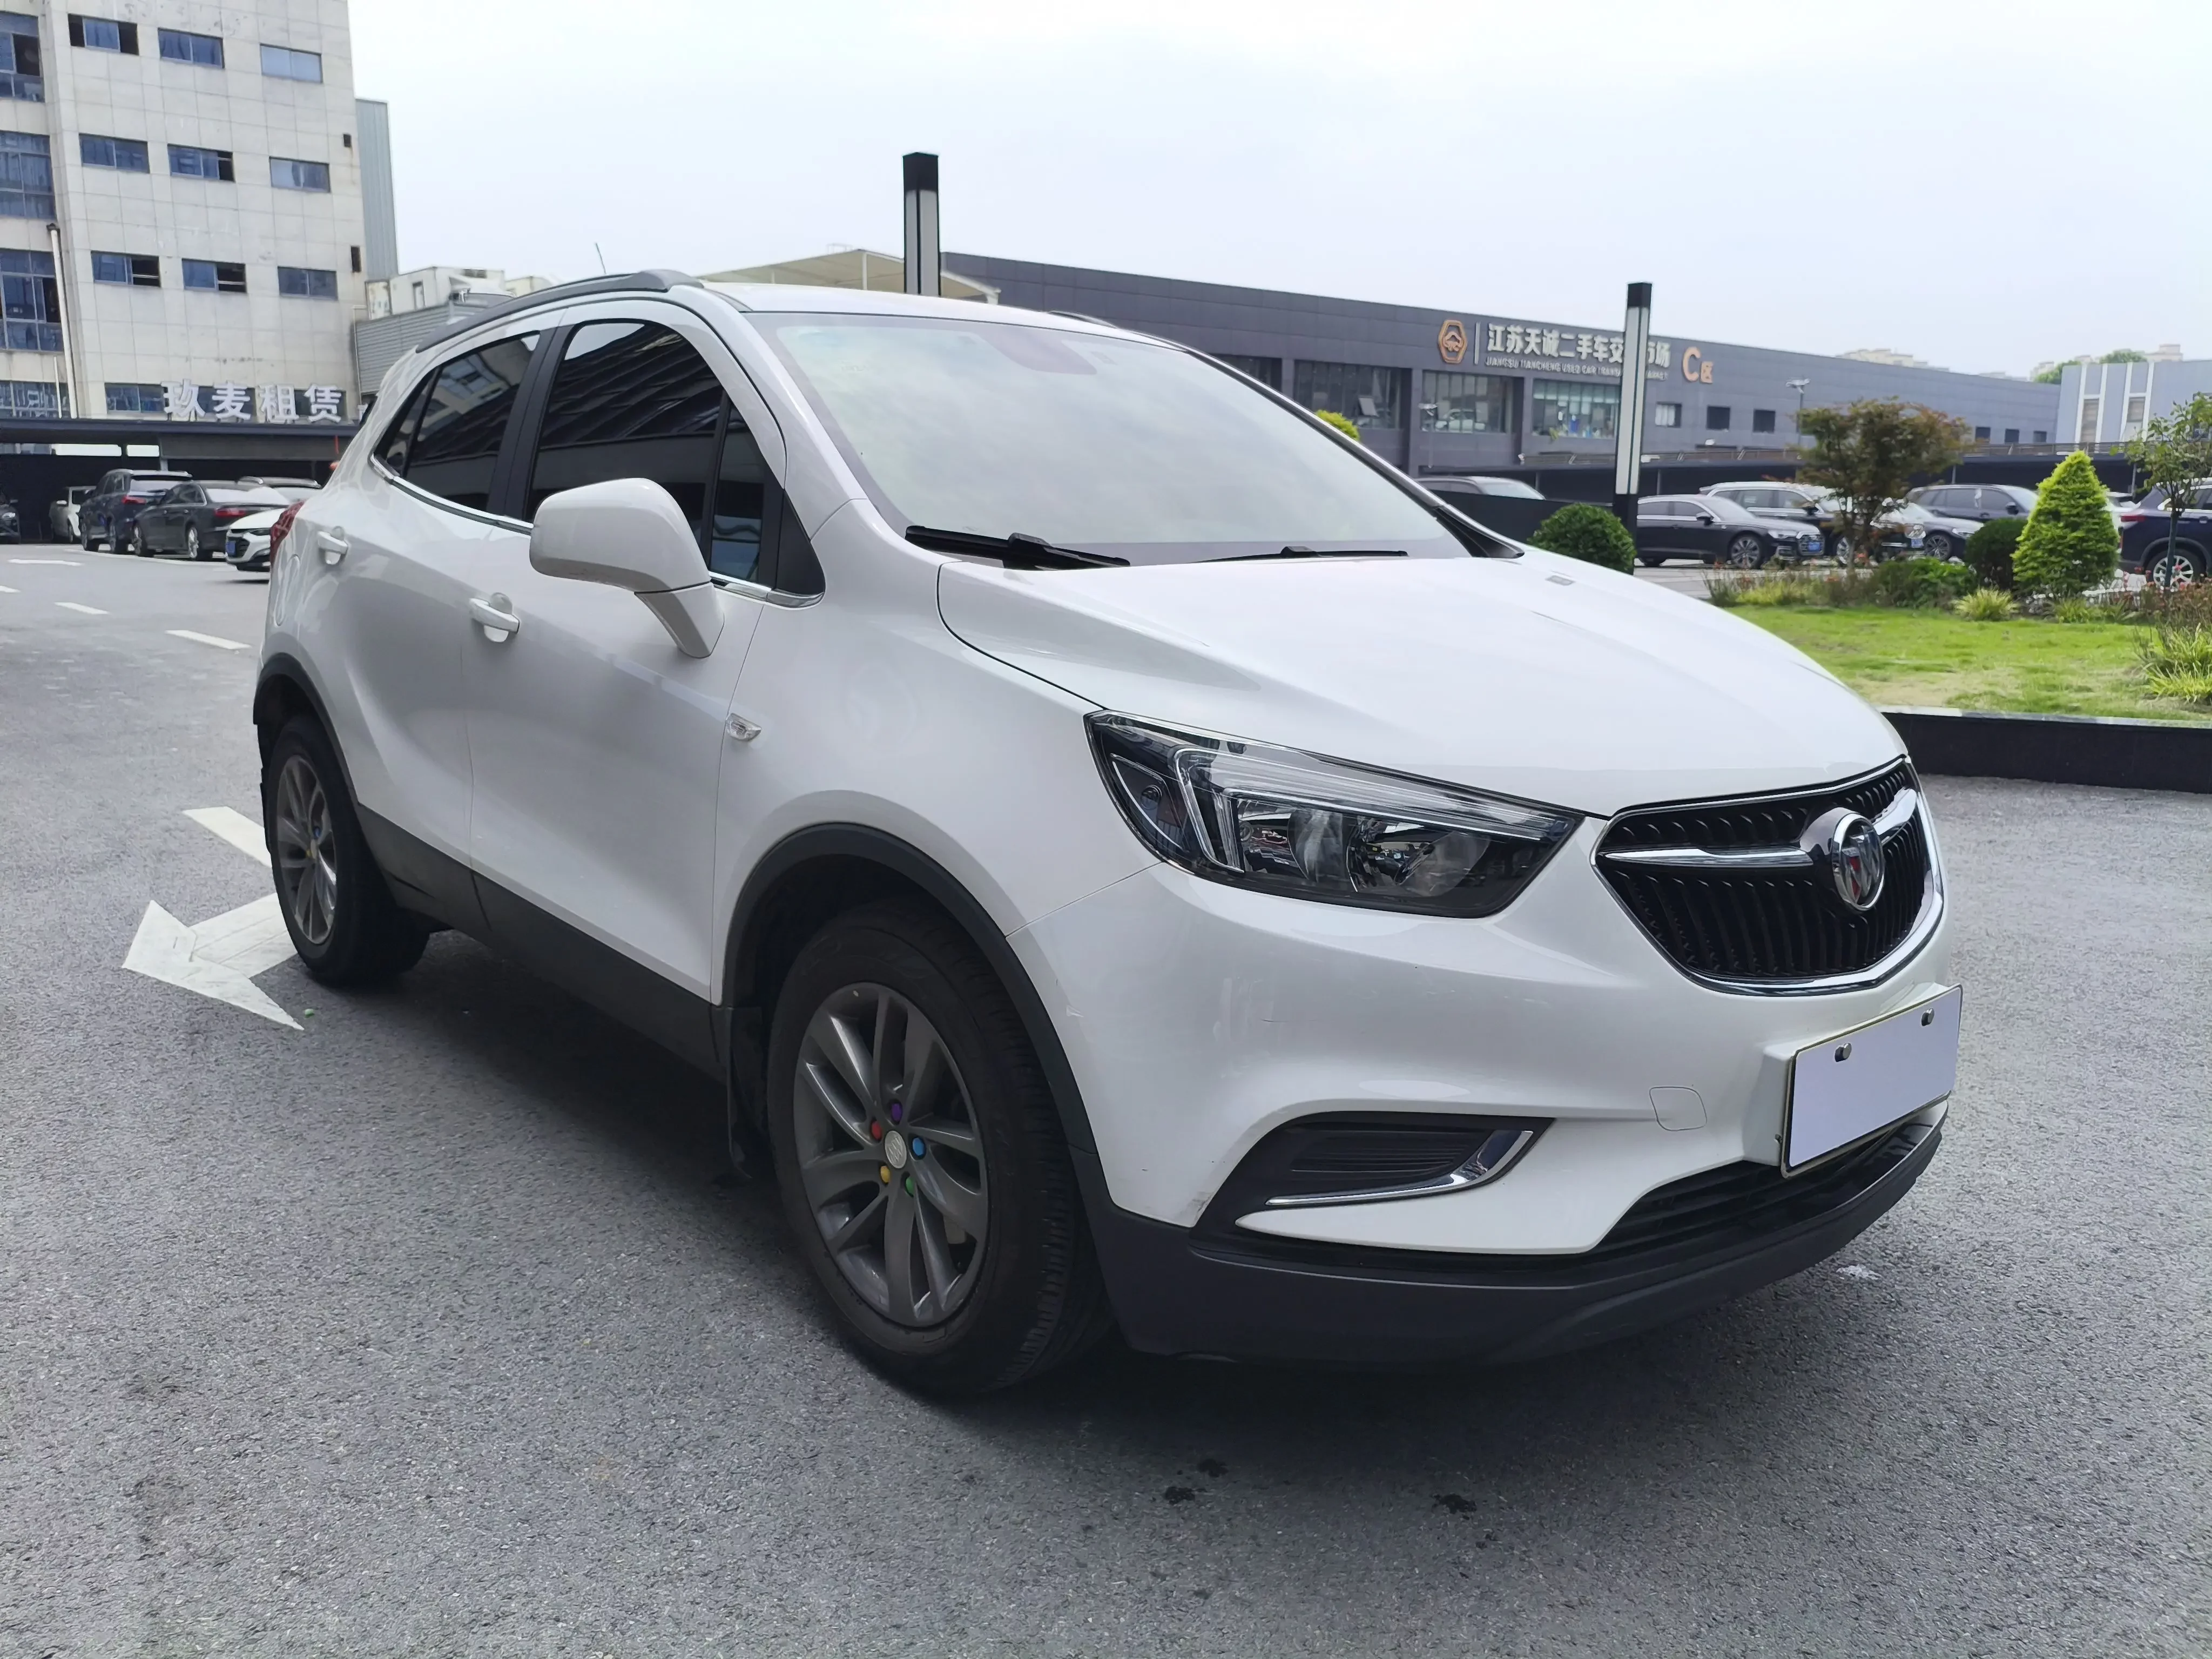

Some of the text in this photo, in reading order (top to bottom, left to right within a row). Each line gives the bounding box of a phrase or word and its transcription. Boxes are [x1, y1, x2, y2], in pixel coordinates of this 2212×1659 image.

[1487, 323, 1670, 368] 江苏天诚二手车交场
[161, 379, 342, 423] 玖麦租赁
